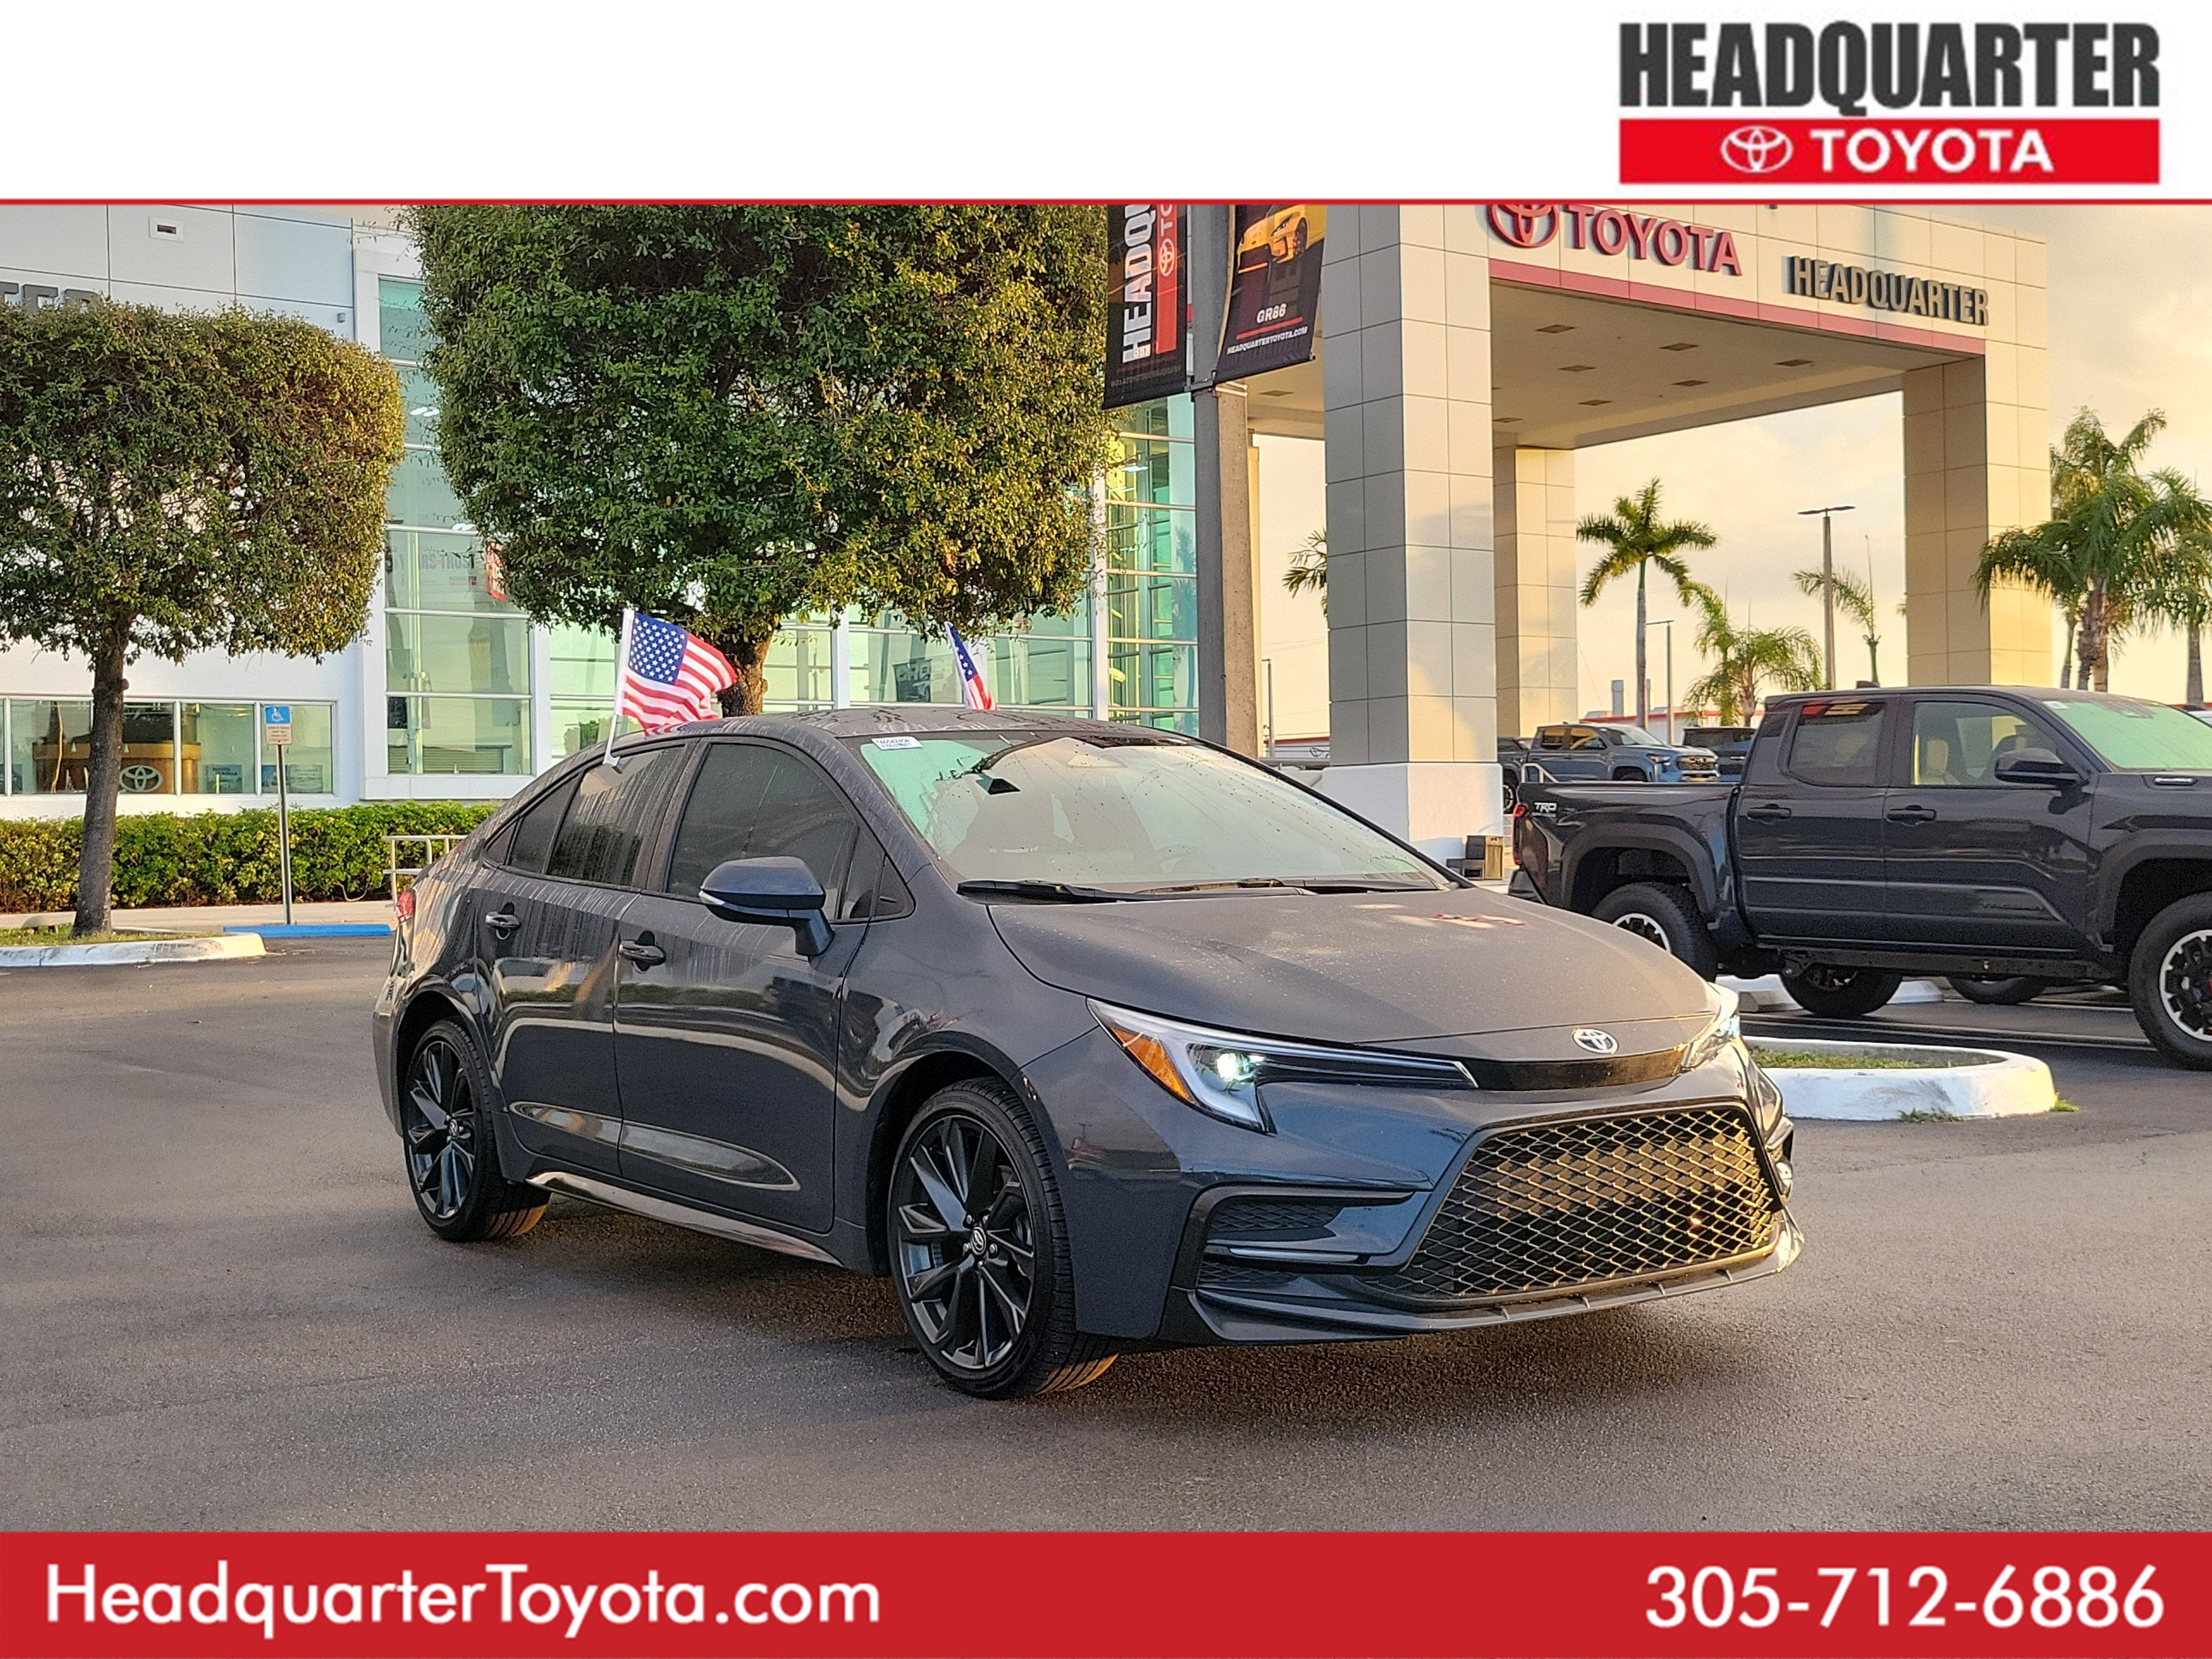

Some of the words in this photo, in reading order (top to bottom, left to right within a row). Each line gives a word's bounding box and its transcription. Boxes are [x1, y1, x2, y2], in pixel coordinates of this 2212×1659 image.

[1565, 204, 1742, 276] TOYOTA
[1790, 256, 1989, 326] HEADQUARTER
[1256, 303, 1286, 324] GR86
[1227, 326, 1308, 355] HEADQUARTERTOYOTA.COM
[1533, 802, 1558, 813] TRD
